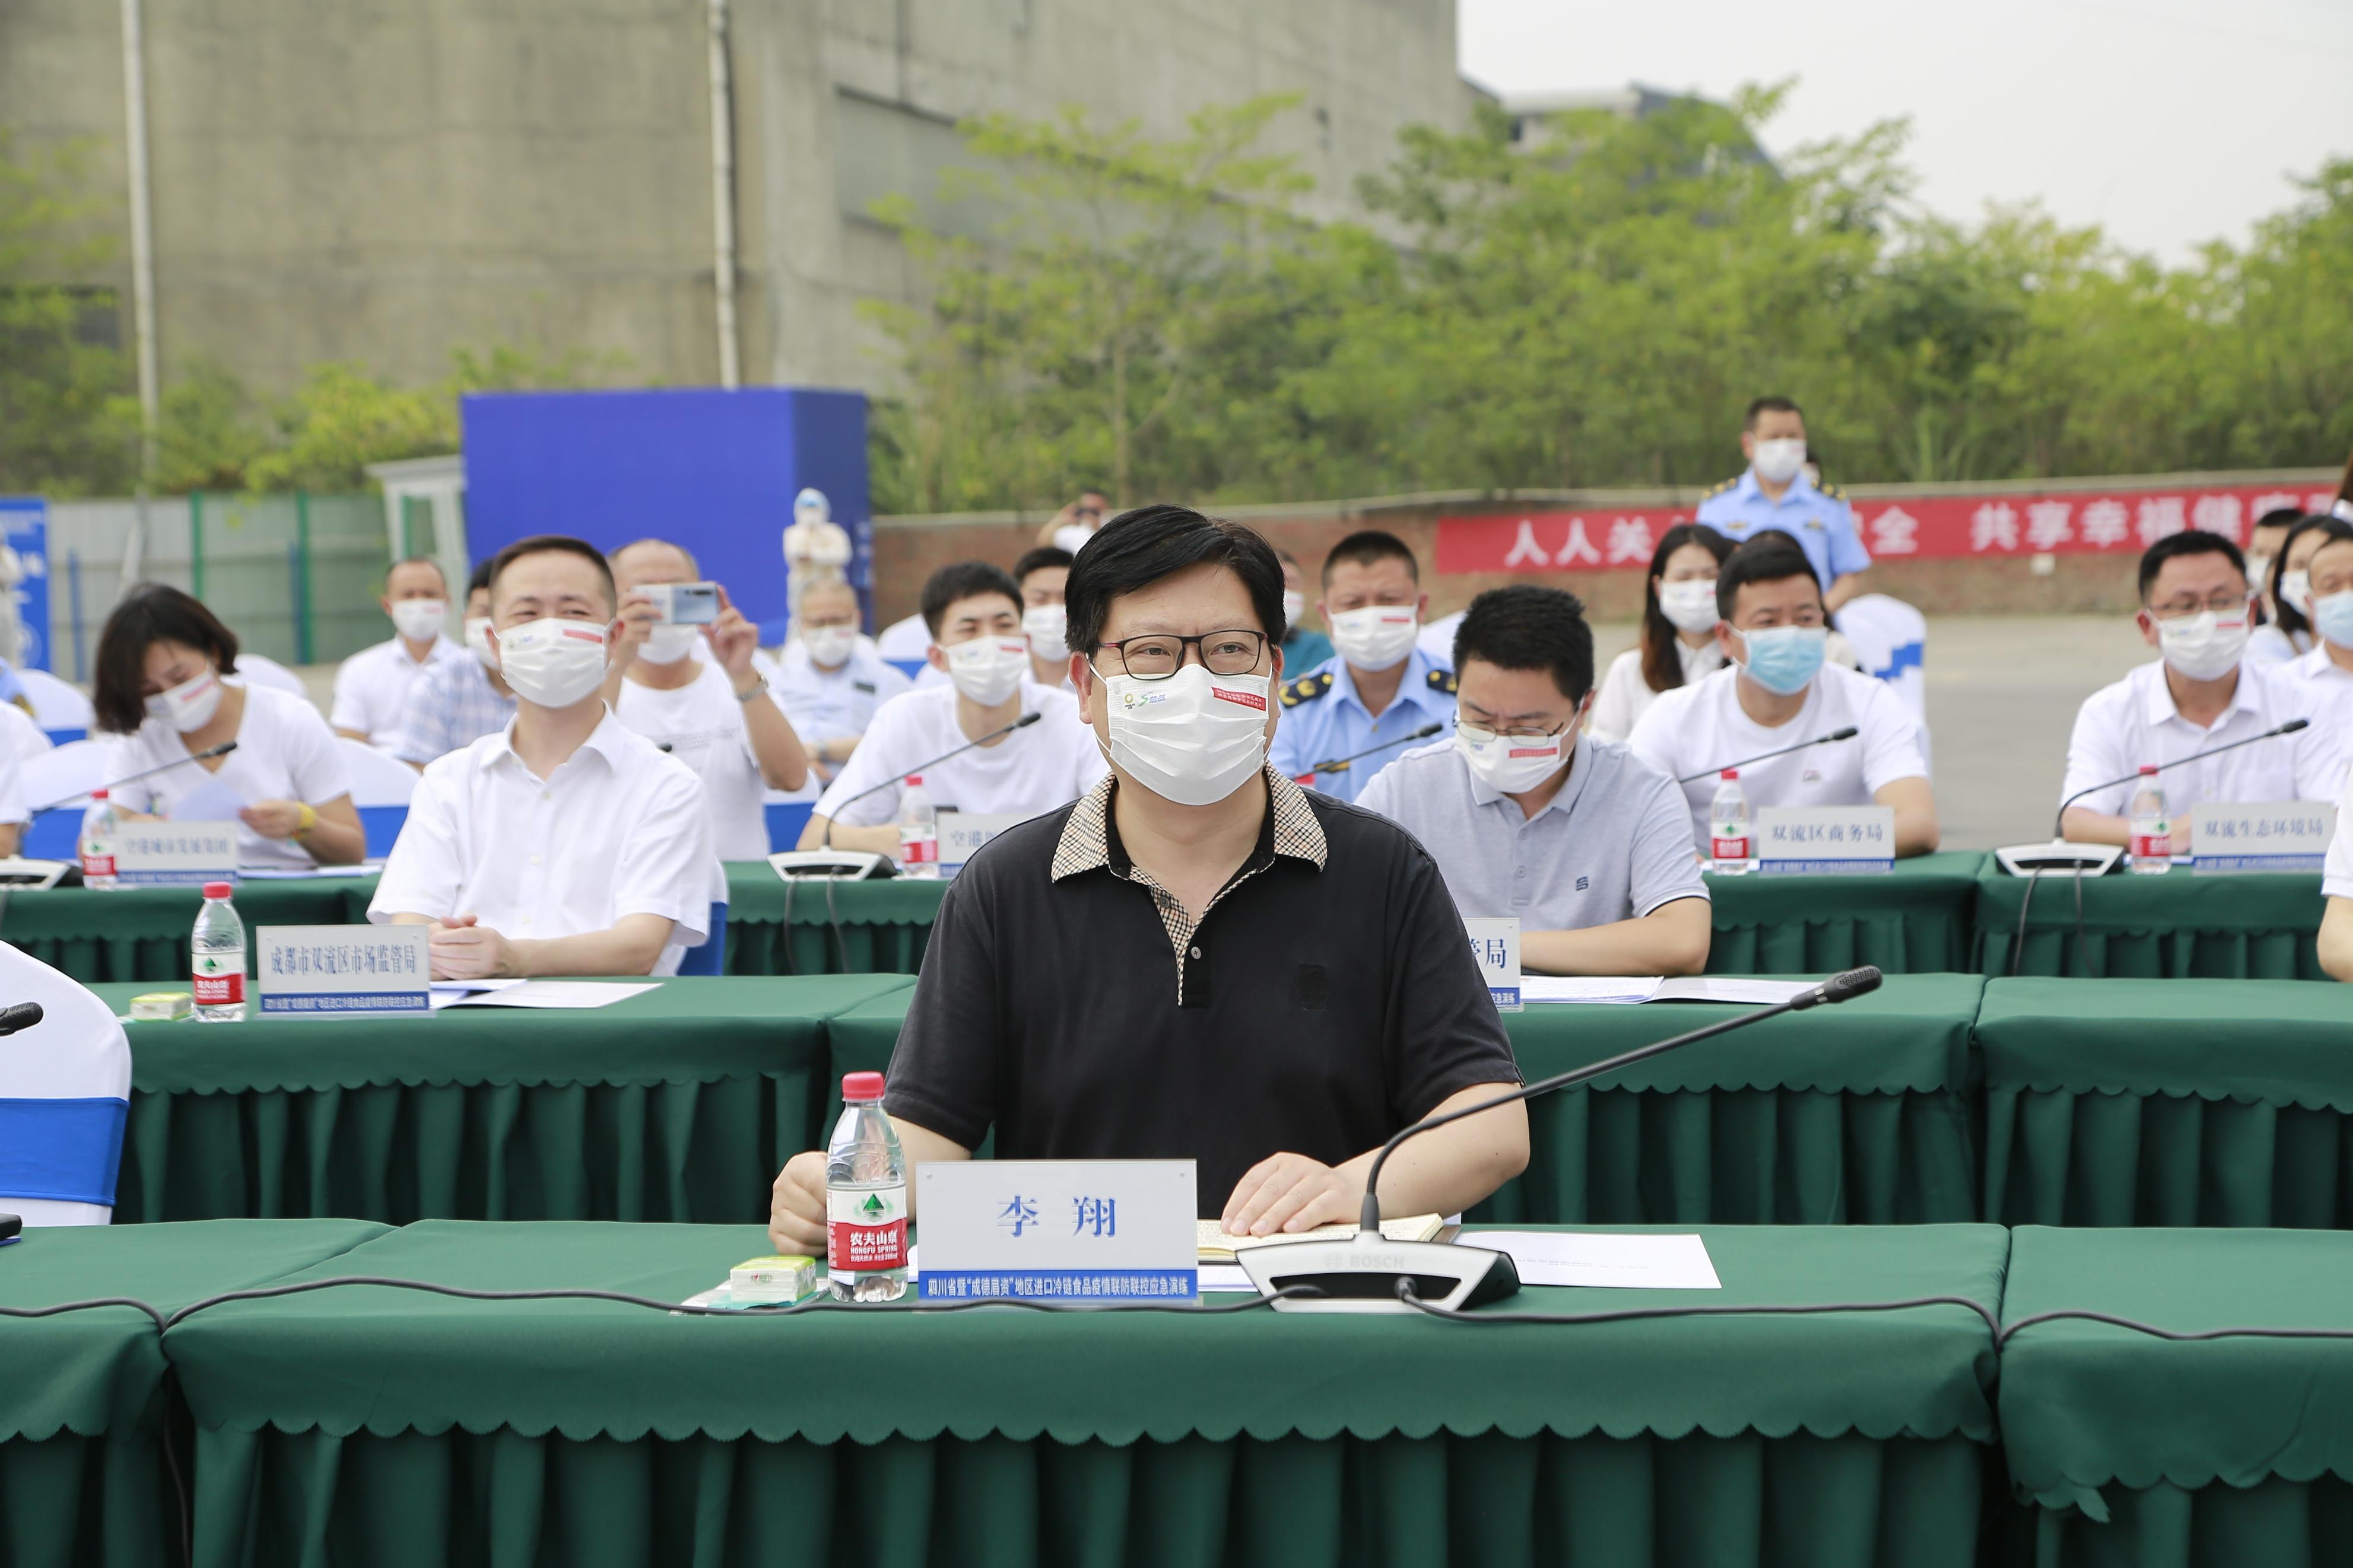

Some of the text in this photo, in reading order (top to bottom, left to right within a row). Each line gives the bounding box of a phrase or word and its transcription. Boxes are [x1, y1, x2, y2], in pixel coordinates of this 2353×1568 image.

[1773, 823, 1883, 842] 双流区商务局
[2206, 816, 2323, 838] 双流生态环境局
[271, 944, 415, 975] 成都市双流区市场监管局
[850, 1230, 897, 1246] 农夫山泉
[850, 1243, 897, 1254] NONGFU SPRING
[1351, 1254, 1405, 1268] BOSCH
